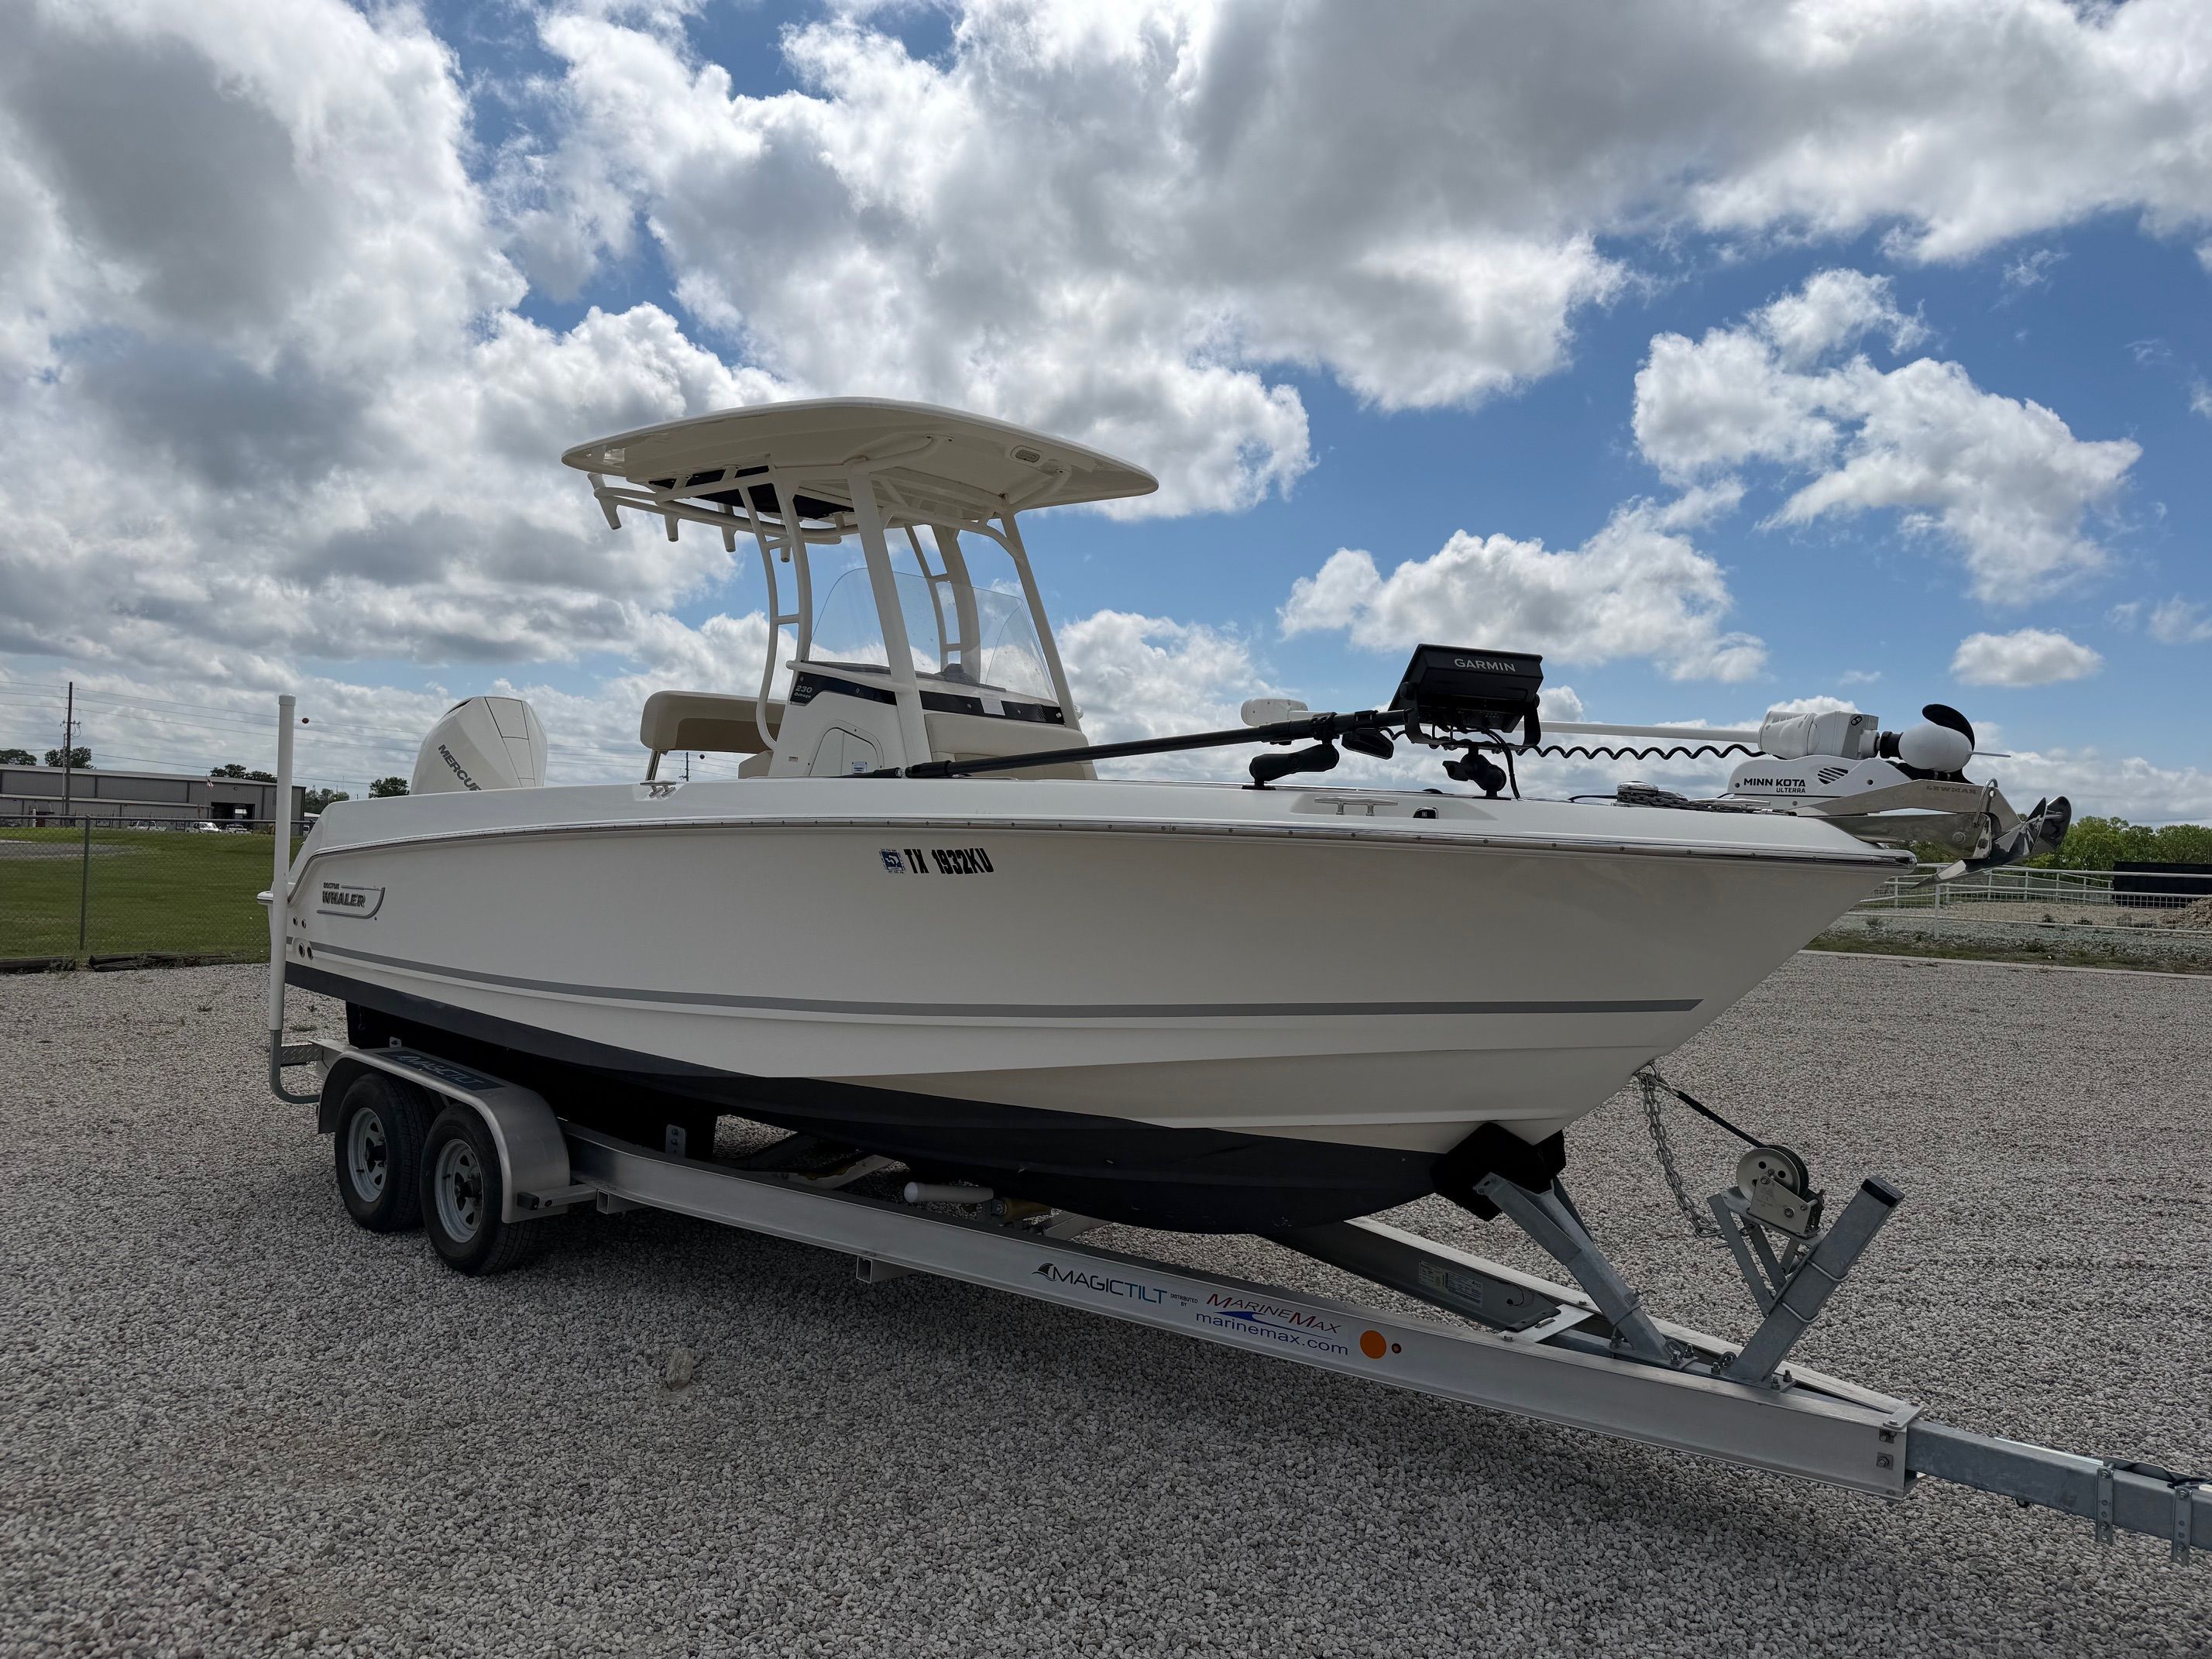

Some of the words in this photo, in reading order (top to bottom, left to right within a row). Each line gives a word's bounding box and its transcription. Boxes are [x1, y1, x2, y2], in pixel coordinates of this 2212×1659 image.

[1454, 658, 1516, 672] GARMIN
[795, 685, 812, 693] 230
[1743, 778, 1773, 787] MINN
[1776, 778, 1806, 788] KOTA
[1926, 785, 1977, 795] LEWMAR
[903, 849, 929, 874] TX
[931, 847, 994, 874] 1932KU
[322, 891, 366, 908] WHALER
[1053, 1266, 1168, 1304] MAGICTILT
[1170, 1293, 1199, 1304] DISTRIBUTED
[1196, 1312, 1348, 1356] marinemax.com
